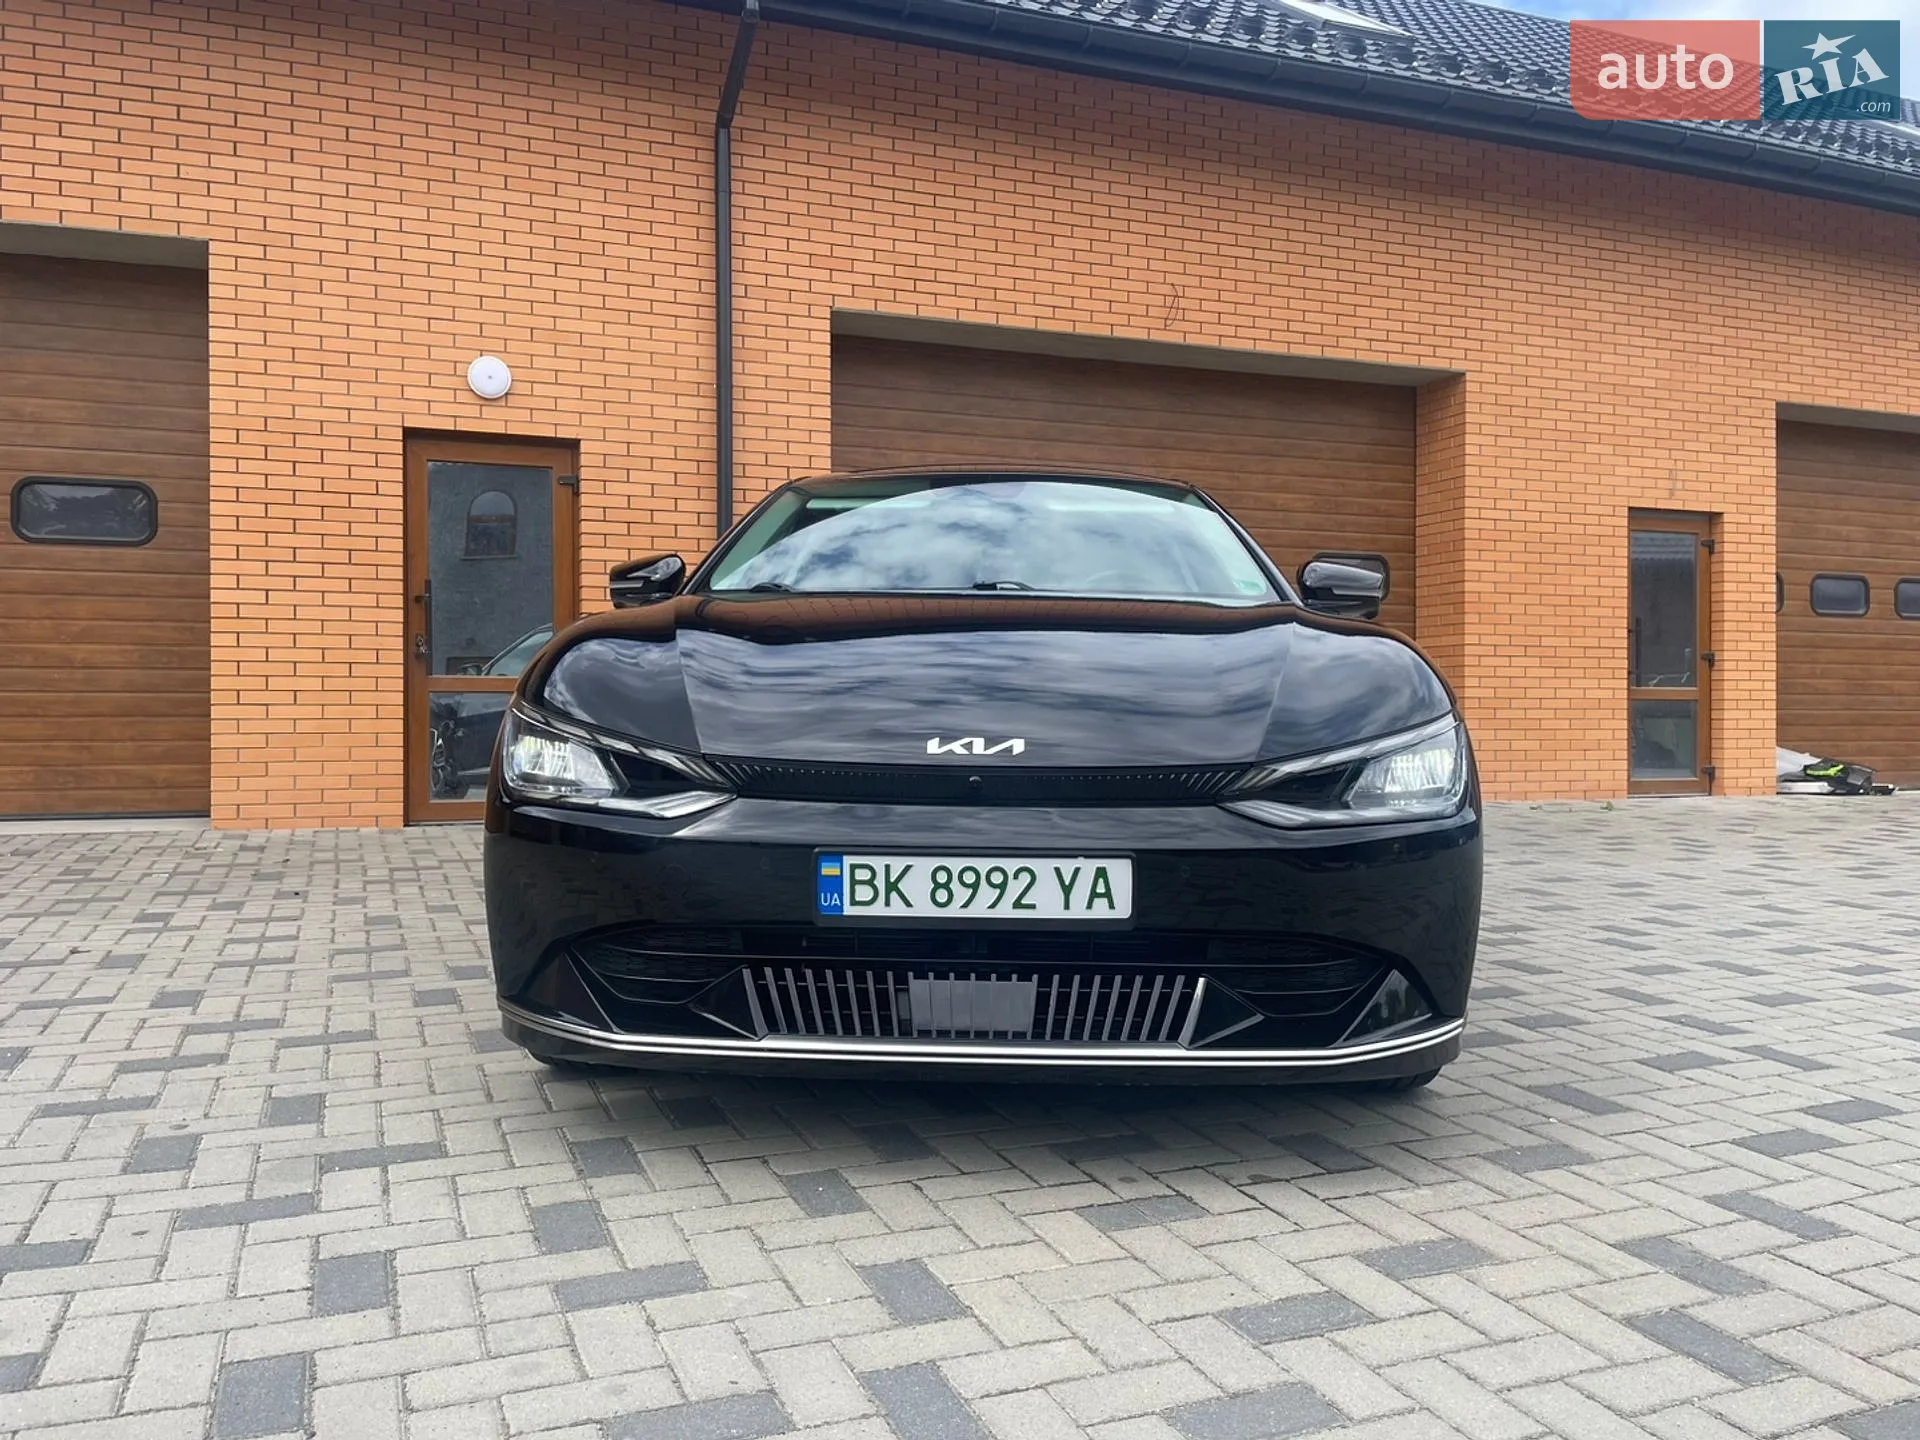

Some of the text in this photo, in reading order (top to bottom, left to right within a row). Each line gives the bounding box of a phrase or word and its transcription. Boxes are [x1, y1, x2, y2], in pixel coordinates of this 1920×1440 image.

[821, 893, 841, 907] UA
[849, 863, 1116, 911] BK 8992 YA
